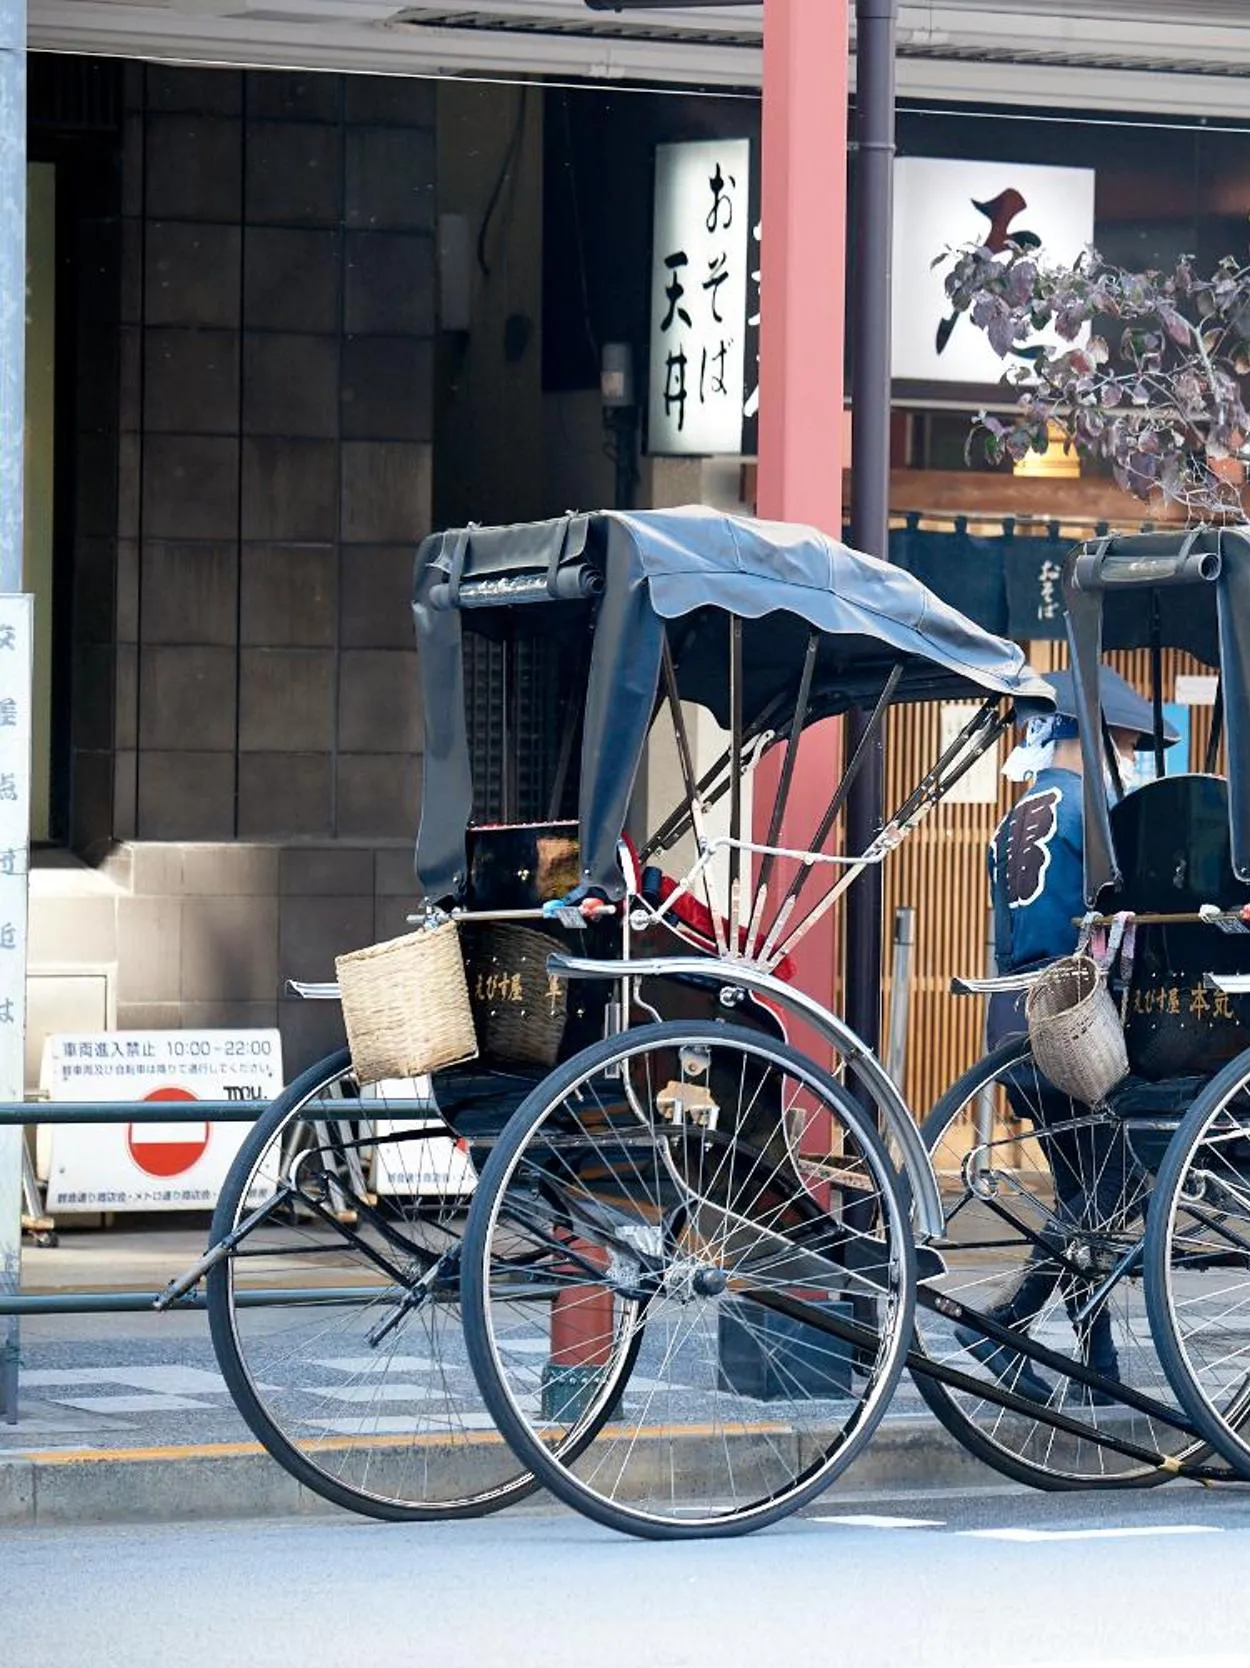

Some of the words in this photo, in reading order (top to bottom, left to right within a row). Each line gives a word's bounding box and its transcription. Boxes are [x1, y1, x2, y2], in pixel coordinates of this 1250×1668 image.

[660, 250, 693, 432] 天丼
[700, 162, 737, 403] おそば
[64, 1040, 156, 1058] 車両進入禁止
